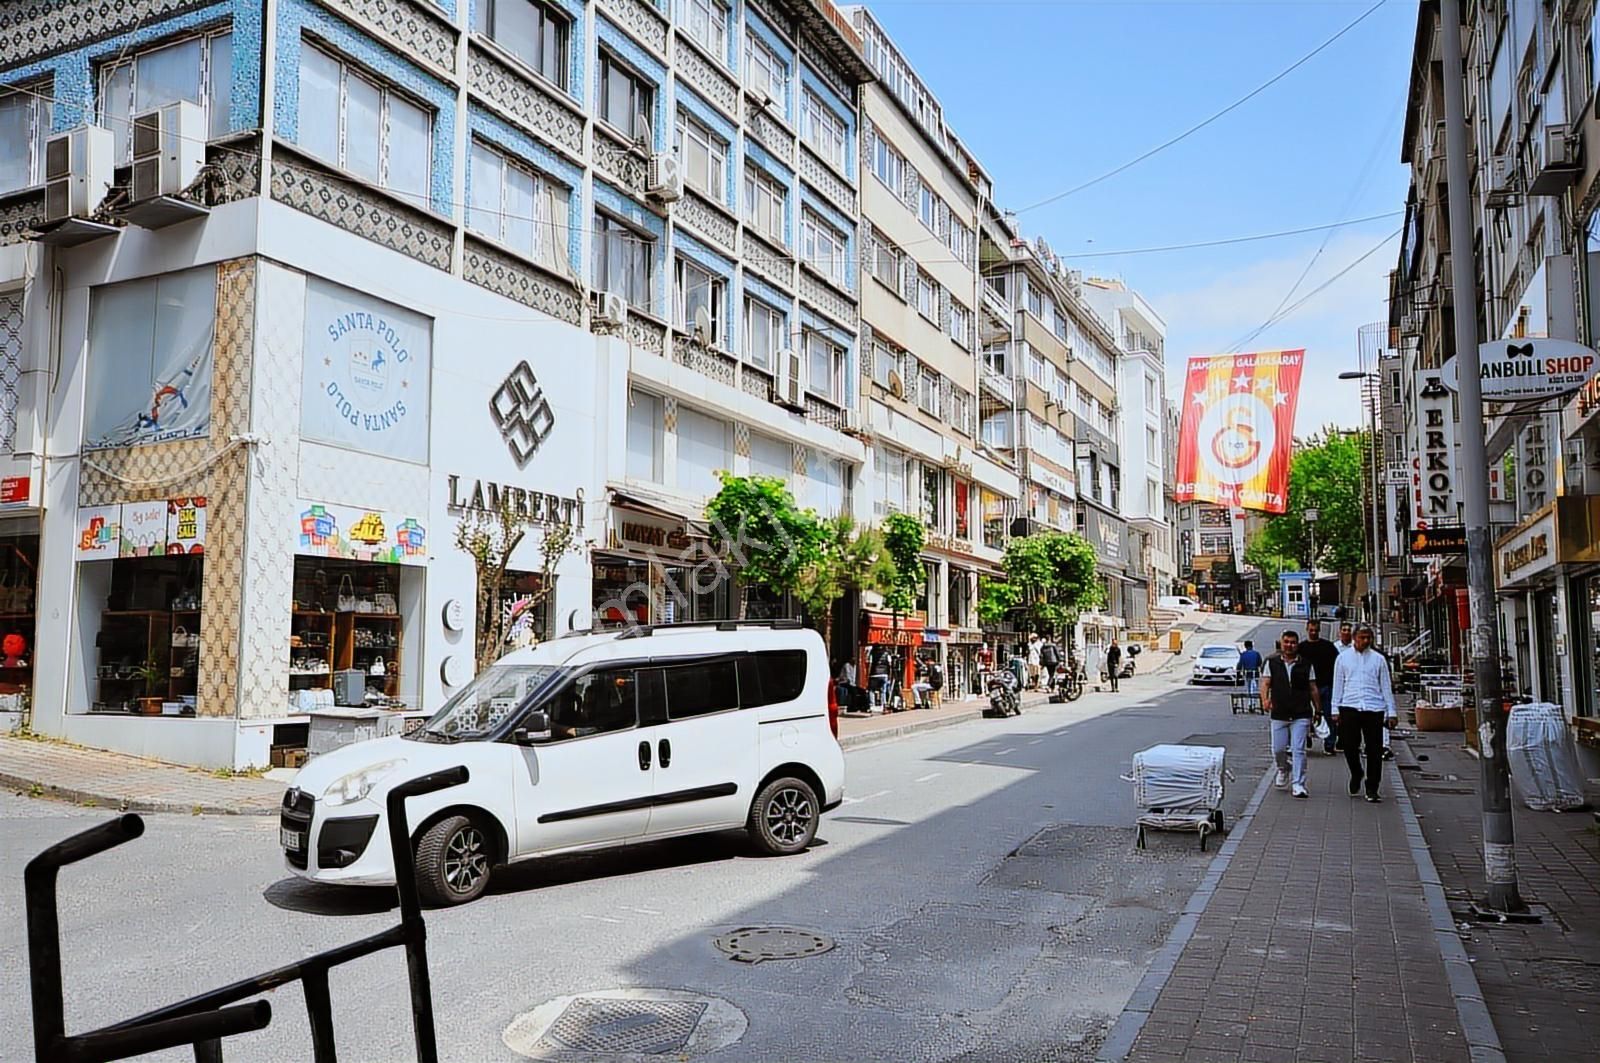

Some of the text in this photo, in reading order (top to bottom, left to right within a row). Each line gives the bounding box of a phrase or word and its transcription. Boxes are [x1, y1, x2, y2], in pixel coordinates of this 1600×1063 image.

[328, 312, 408, 363] SANTA POLO
[327, 381, 407, 432] SANTA POLO
[350, 523, 385, 541] SALE
